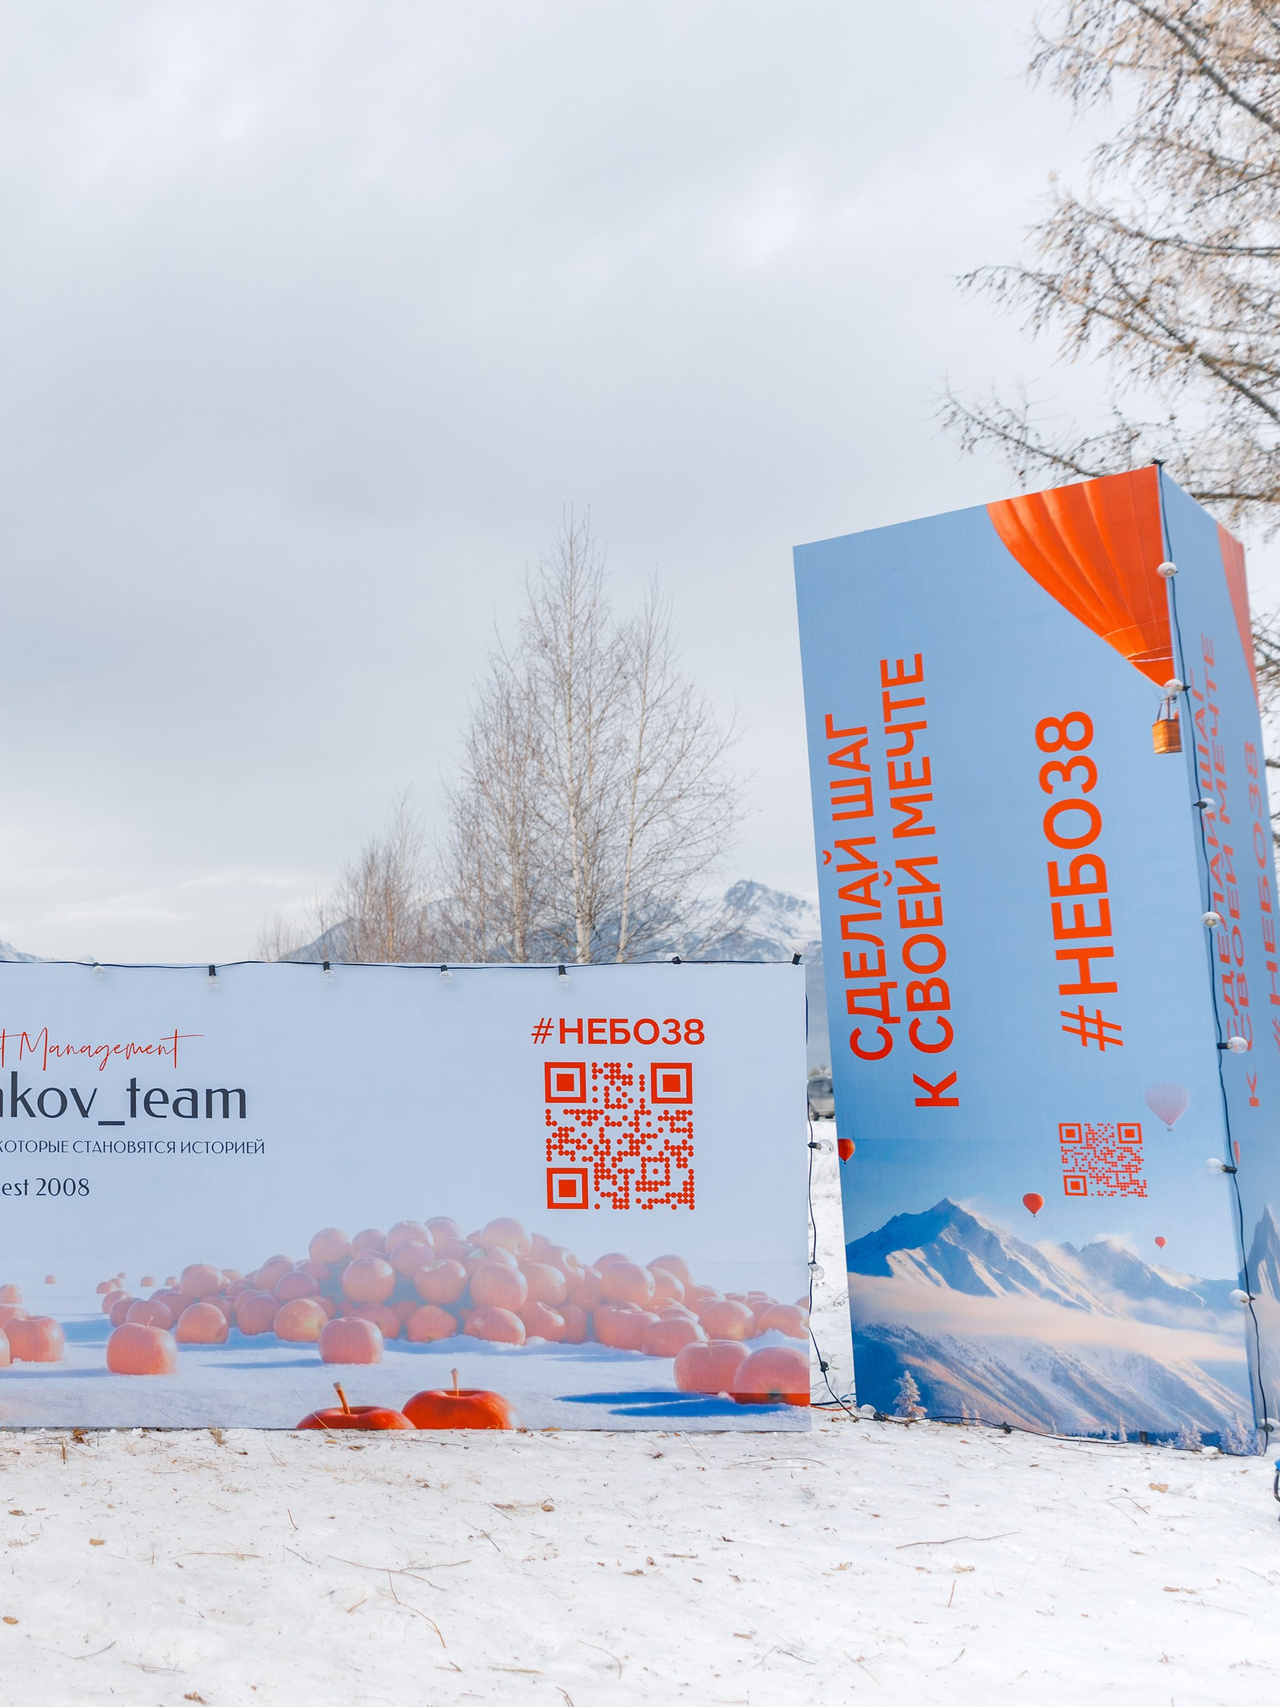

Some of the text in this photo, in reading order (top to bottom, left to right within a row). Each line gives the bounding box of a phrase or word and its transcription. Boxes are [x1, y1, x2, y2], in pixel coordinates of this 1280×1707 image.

[1190, 668, 1214, 792] ШАГ
[822, 713, 894, 1061] СДЕЛАЙ ШАГ
[879, 652, 960, 1108] К СВОЕЙ МЕЧТЕ
[1034, 710, 1125, 1052] #НЕБО38
[1201, 631, 1261, 1108] К СВОЕЙ МЕЧТЕ
[19, 1027, 204, 1072] Management
[530, 1017, 706, 1046] #НЕБО38
[1, 1177, 90, 1197] est 2008
[72, 1140, 176, 1154] СТАНОВЯТСЯ
[180, 1138, 265, 1155] ИСТОРИЕЙ
